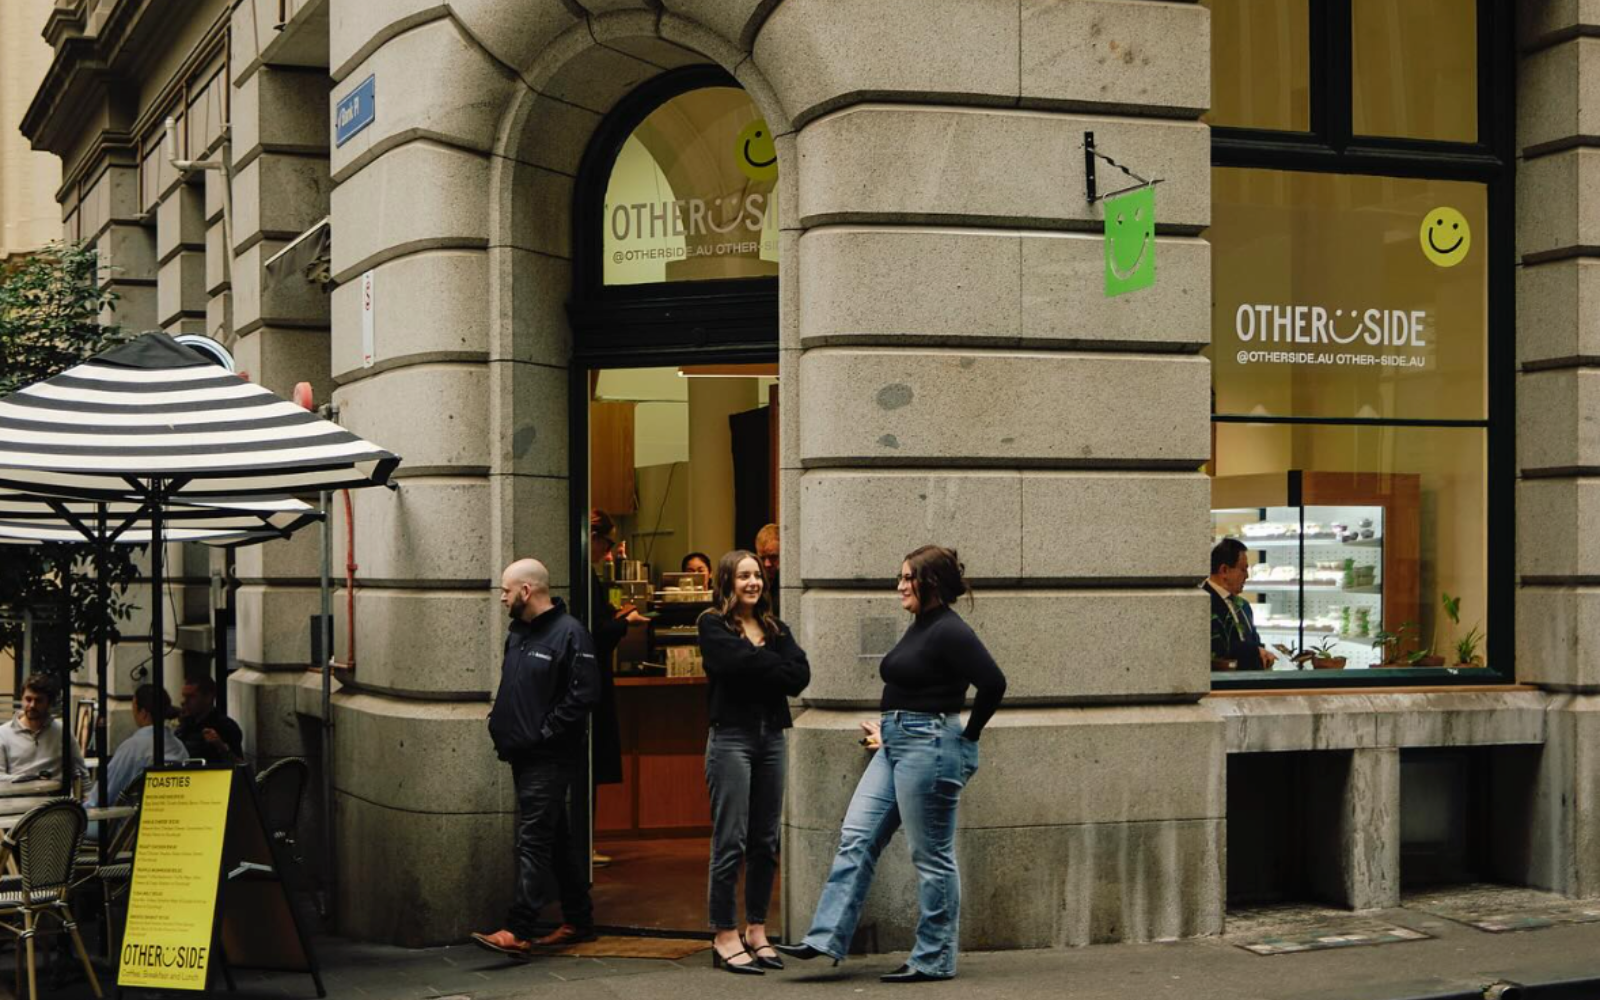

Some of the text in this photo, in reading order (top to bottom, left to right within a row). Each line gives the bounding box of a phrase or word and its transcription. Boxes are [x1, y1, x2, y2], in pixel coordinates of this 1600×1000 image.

[612, 193, 778, 241] OTHER SI
[613, 240, 778, 264] @OTHERSIDE.AU OTHER-SI
[1235, 304, 1426, 346] OTHER SIDE
[1236, 350, 1425, 367] @OTHERSIDE.AU OTHER-SIDE.AU
[147, 776, 191, 788] TOASTIES
[123, 944, 206, 969] OTHER SIDE
